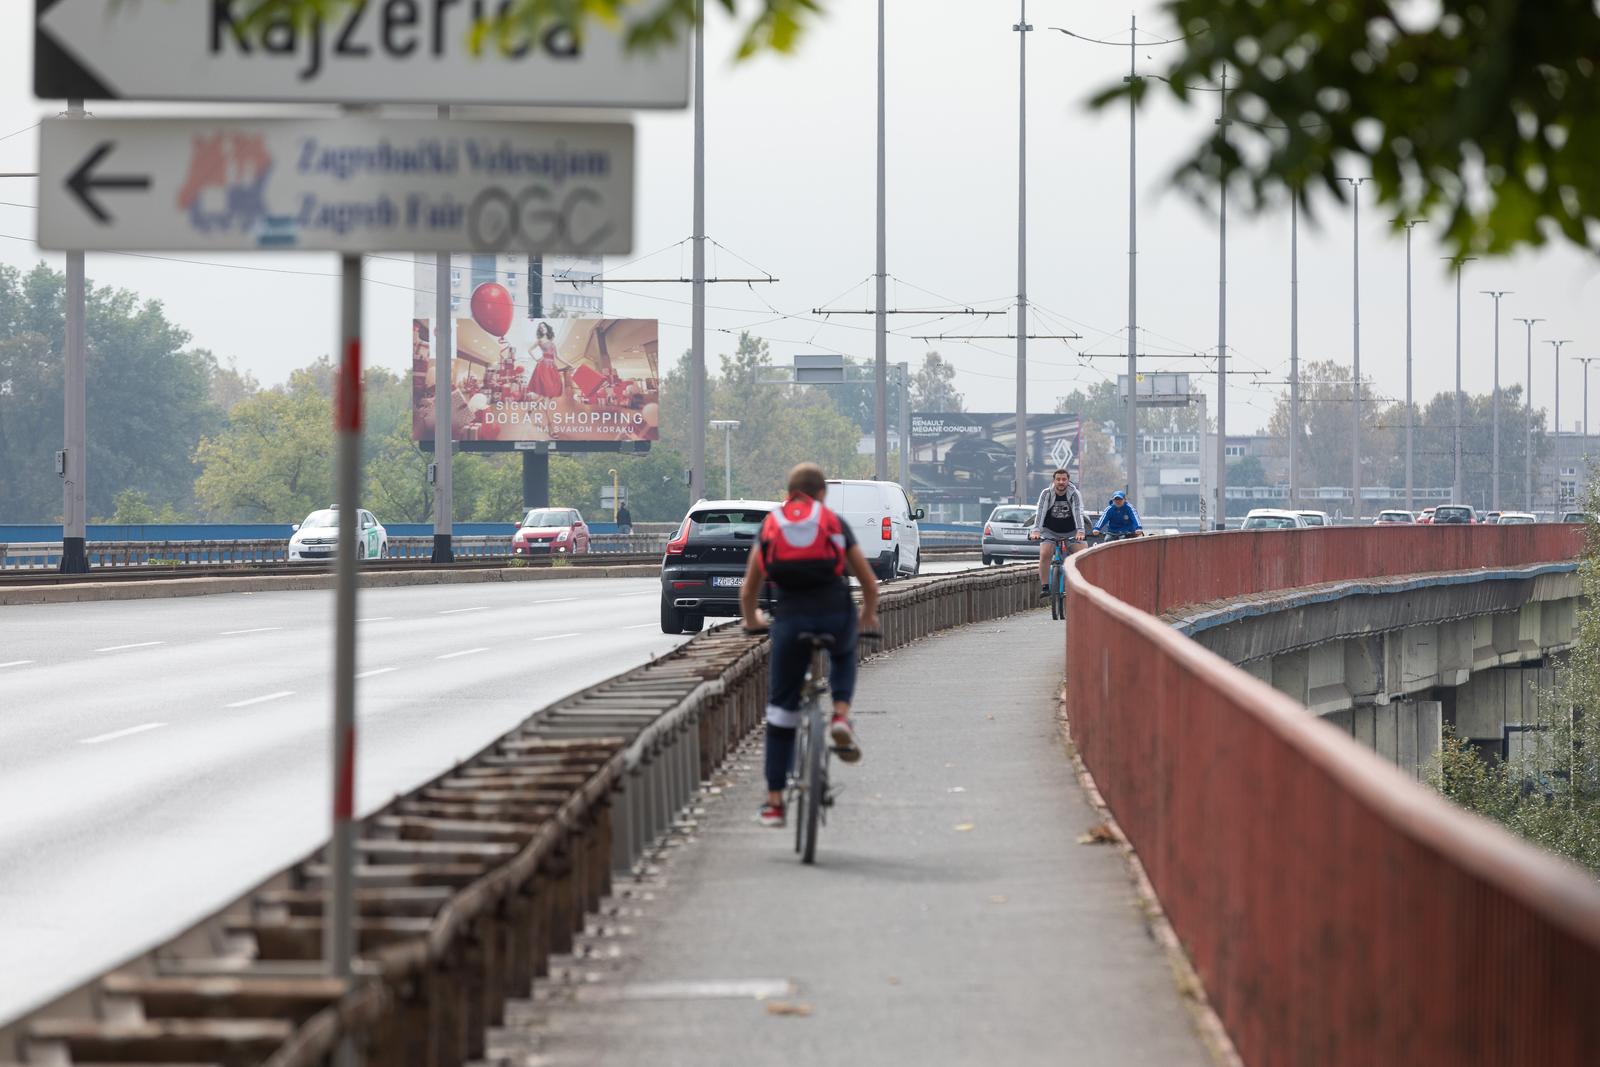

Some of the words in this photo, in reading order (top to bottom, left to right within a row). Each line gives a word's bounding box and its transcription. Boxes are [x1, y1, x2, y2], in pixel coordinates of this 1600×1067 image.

[299, 193, 398, 236] Zagreb
[405, 193, 464, 231] Fair
[495, 401, 557, 411] SIGURNO
[485, 412, 544, 425] DOBAR
[552, 412, 644, 425] SHOPPING
[536, 425, 550, 433] NA
[554, 425, 593, 434] SVAKOM
[596, 425, 635, 434] KORAKU
